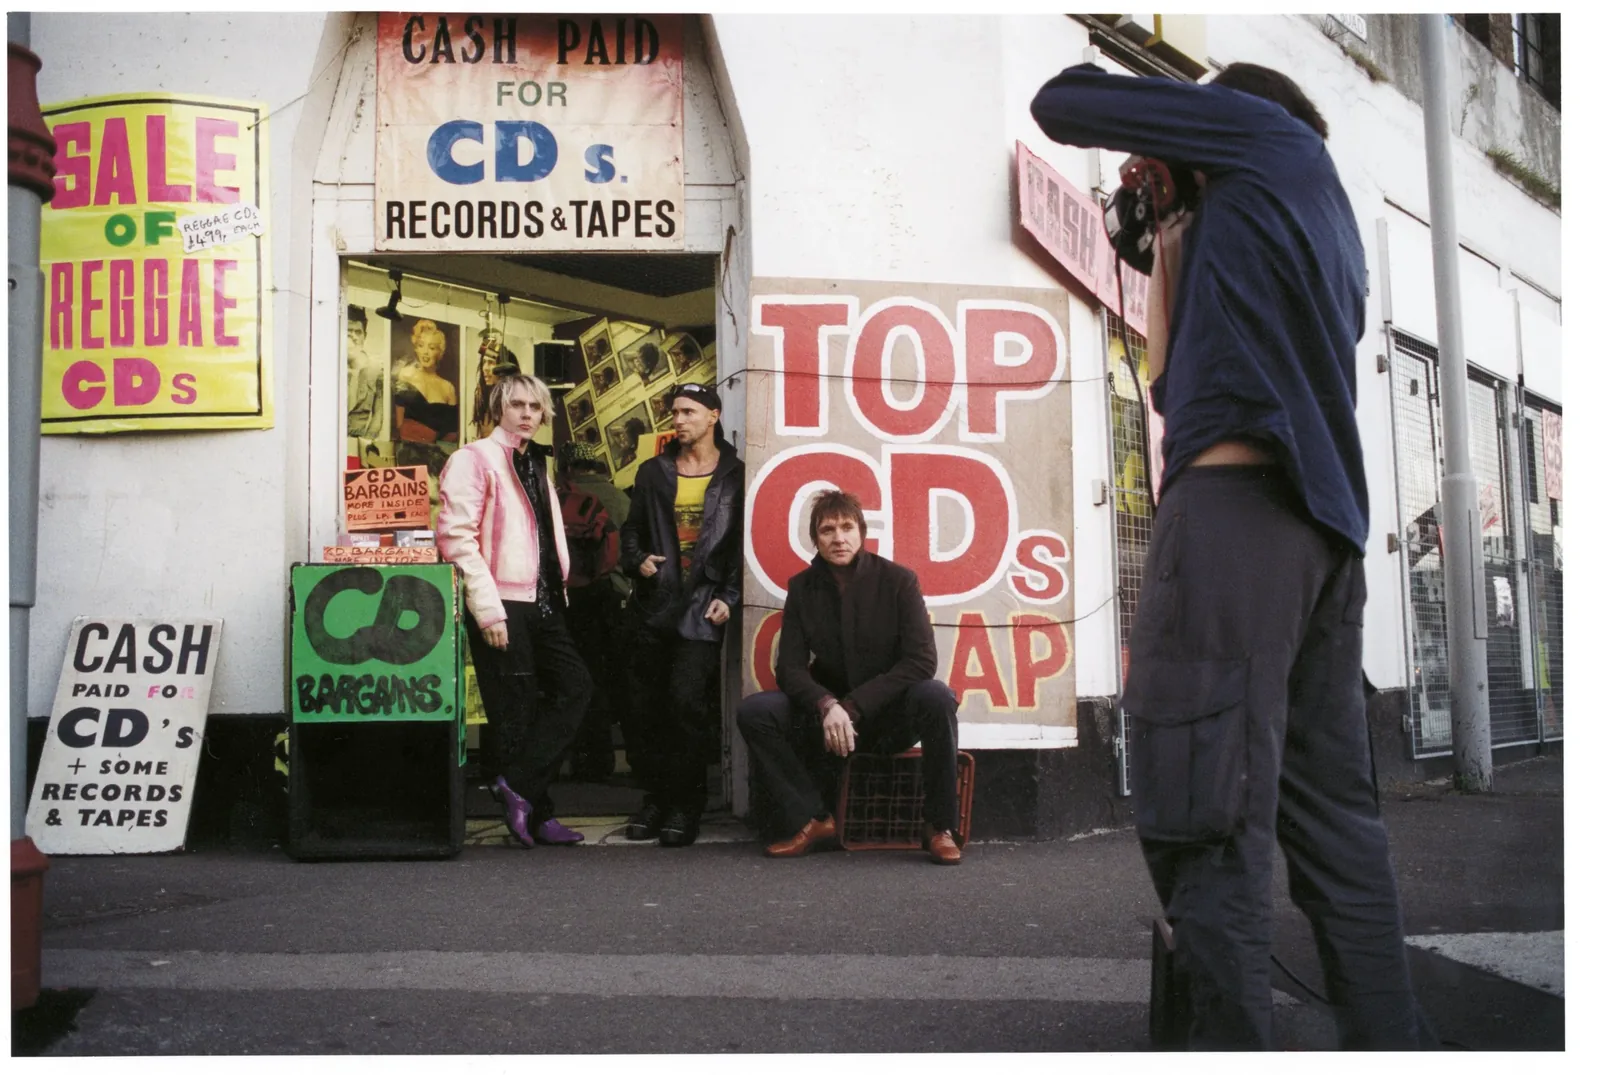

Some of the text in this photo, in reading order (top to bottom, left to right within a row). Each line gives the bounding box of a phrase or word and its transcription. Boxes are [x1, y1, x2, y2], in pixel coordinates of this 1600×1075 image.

[402, 15, 660, 65] CASH PAID
[496, 81, 568, 107] FOR
[50, 115, 240, 210] SALE
[105, 211, 176, 247] OF
[183, 213, 229, 232] REGGAE
[233, 222, 260, 234] EACH
[386, 200, 676, 239] RECORDS & TAPES
[1027, 159, 1098, 279] CASH
[50, 258, 240, 350] REGGAE
[61, 357, 198, 410] CDs
[755, 298, 1064, 441] TOP
[344, 481, 428, 501] BARGAINS
[366, 469, 397, 483] CD
[347, 498, 424, 510] MORE INSIDE
[746, 444, 1071, 604] CDs
[351, 547, 435, 556] BARGAINS
[304, 567, 446, 666] CD
[73, 622, 213, 675] CASH
[72, 683, 194, 699] PAID FOR
[100, 760, 169, 775] SOME
[41, 783, 183, 803] RECORDS
[45, 808, 168, 828] & TAPES
